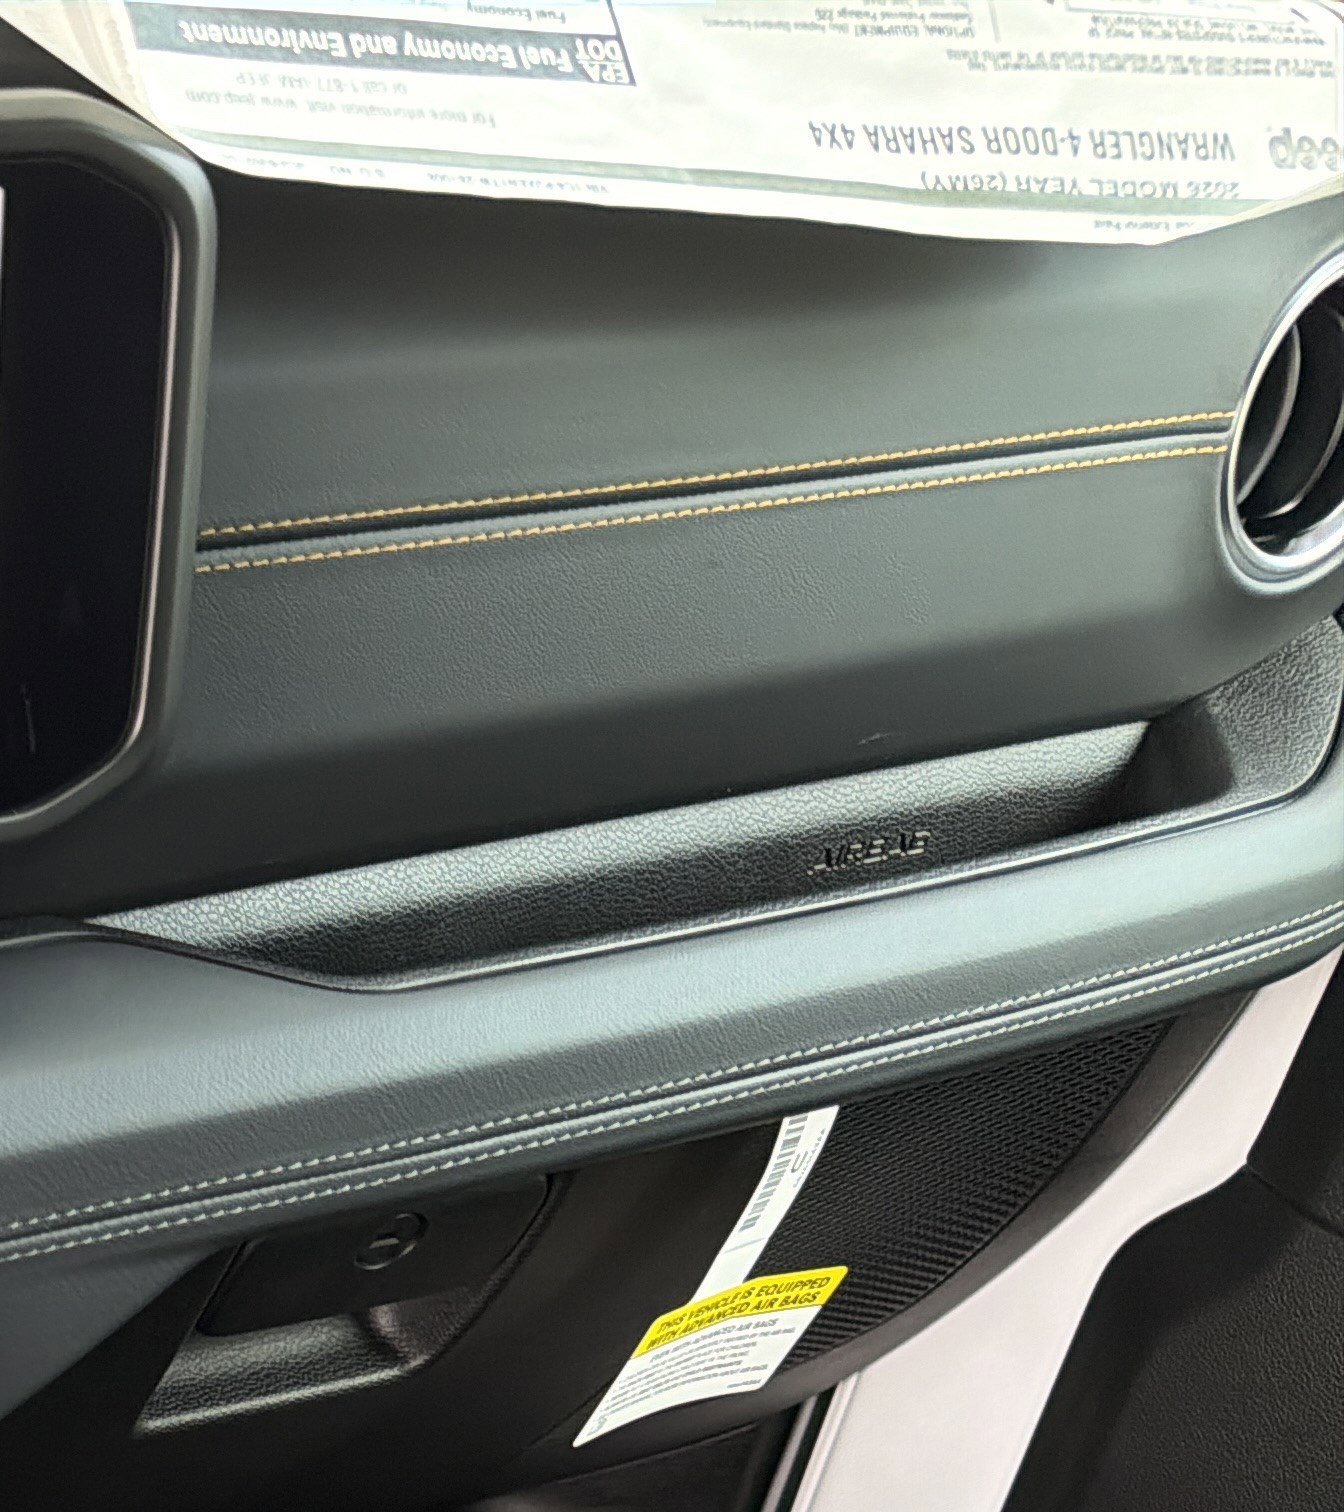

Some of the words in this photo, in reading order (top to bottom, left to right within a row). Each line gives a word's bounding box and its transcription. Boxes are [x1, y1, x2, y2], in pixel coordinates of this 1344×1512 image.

[466, 0, 534, 23] Economy
[534, 9, 566, 24] Fuel
[177, 19, 349, 59] Environment
[349, 31, 399, 60] and
[404, 29, 518, 70] Economy
[574, 37, 624, 61] DOT
[518, 44, 575, 73] Fuel
[580, 60, 630, 84] EPA
[808, 120, 856, 150] 4X4
[862, 123, 976, 154] SAHARA
[981, 126, 1081, 158] 4-DOOR
[1089, 128, 1237, 161] WRANGLER
[920, 170, 1008, 192] (26MY)
[1015, 174, 1084, 195] YEAR
[1090, 178, 1179, 198] MODEL
[646, 1329, 678, 1349] WITH
[681, 1301, 751, 1334] ADVANCED
[749, 1297, 776, 1312] AIR
[777, 1290, 821, 1308] BAGS
[656, 1312, 686, 1334] THIS
[688, 1291, 741, 1320] VEHICLE
[740, 1286, 757, 1300] IS
[755, 1276, 831, 1299] EQUIPPED
